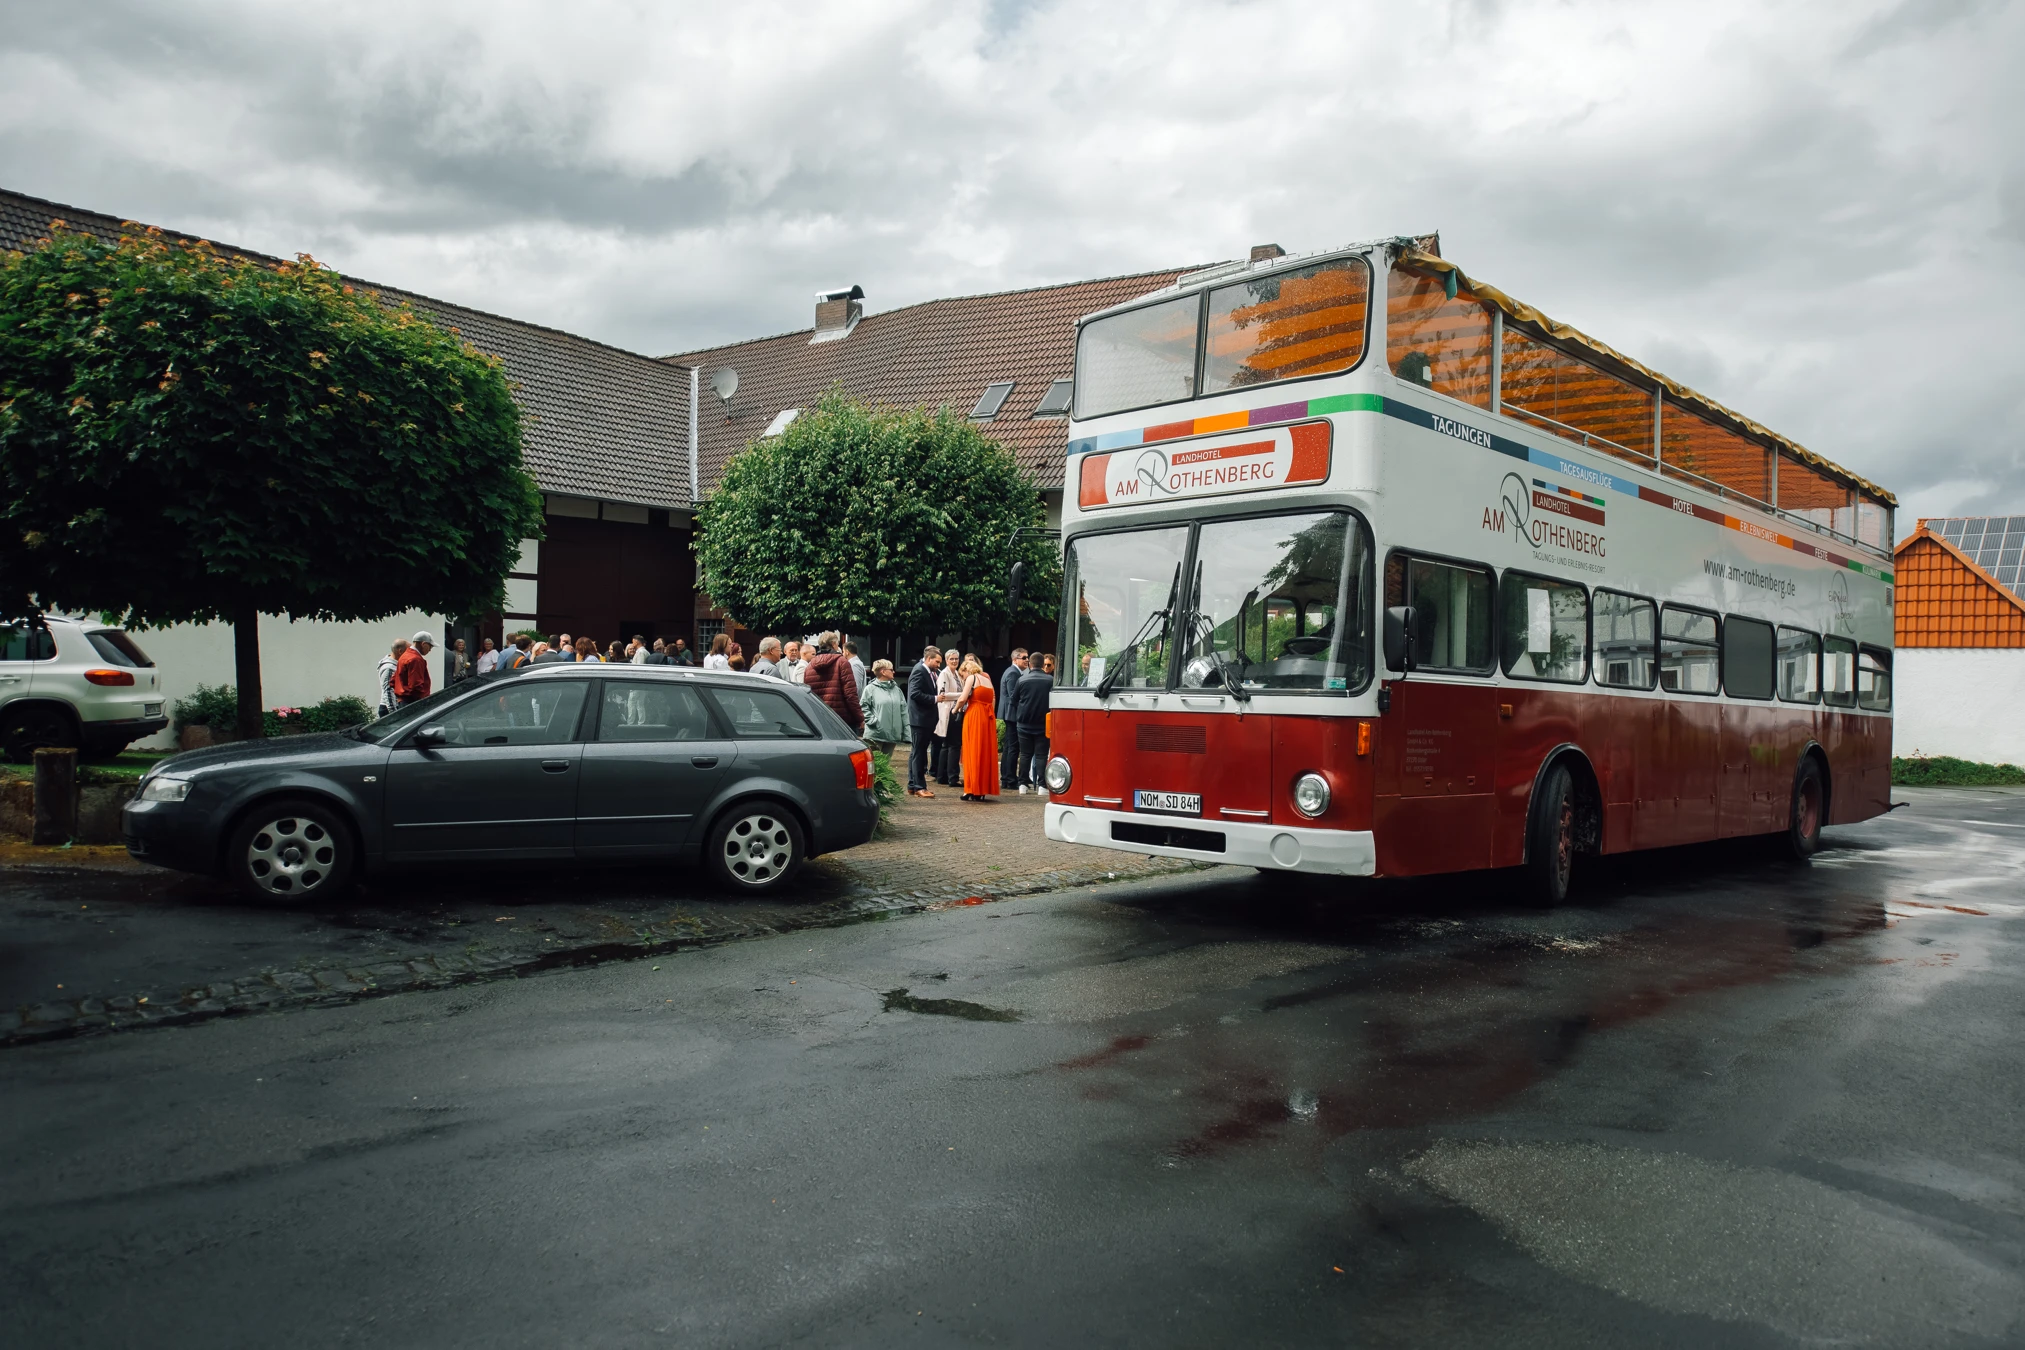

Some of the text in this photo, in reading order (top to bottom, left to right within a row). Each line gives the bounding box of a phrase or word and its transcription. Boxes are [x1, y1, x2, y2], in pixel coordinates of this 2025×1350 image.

[1431, 415, 1491, 449] TAGUNGEN
[1176, 449, 1222, 464] LANDHOTEL
[1115, 448, 1275, 497] AM ROTHENBERG
[1559, 461, 1612, 489] TAGESAUSFLÜGE
[1536, 494, 1571, 515] LANDHOTEL
[1672, 498, 1694, 516] HOTEL
[1482, 506, 1505, 534] AM
[1740, 520, 1778, 544] ERLEBNISWELT
[1532, 550, 1606, 574] TAGUNGS- UND ERLEBNIS-RESORT
[1814, 547, 1828, 561] FESTE
[1703, 557, 1796, 600] www.am-rothenberg.de
[1140, 793, 1200, 810] NOM SD 84H
